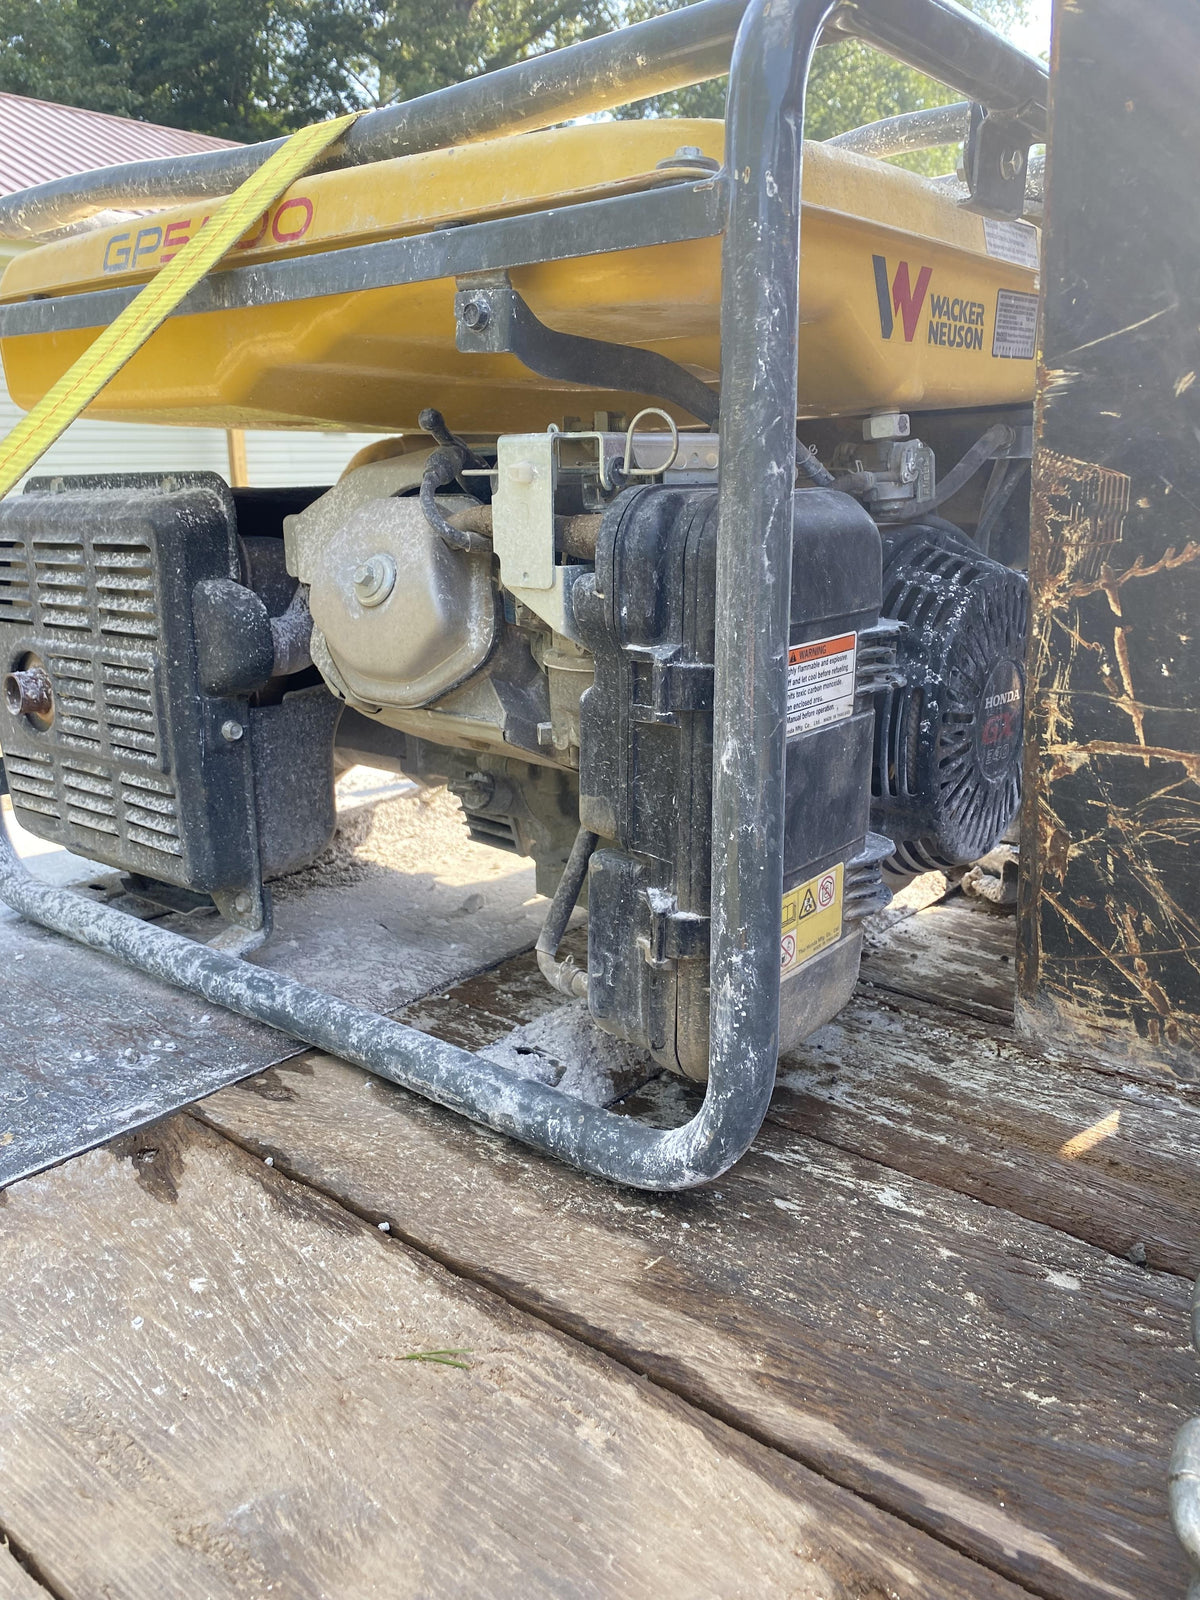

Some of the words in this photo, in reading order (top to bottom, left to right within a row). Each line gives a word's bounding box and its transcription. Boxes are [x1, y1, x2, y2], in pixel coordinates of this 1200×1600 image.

[931, 294, 984, 326] WACKER
[928, 320, 983, 350] NEUSON
[799, 645, 827, 660] WARNING
[821, 659, 829, 667] and
[792, 678, 801, 686] and
[817, 669, 831, 679] before
[796, 689, 806, 698] toxic
[807, 685, 822, 695] carbon
[985, 689, 1020, 709] HONDA
[793, 698, 812, 710] enclosed
[802, 710, 815, 720] before
